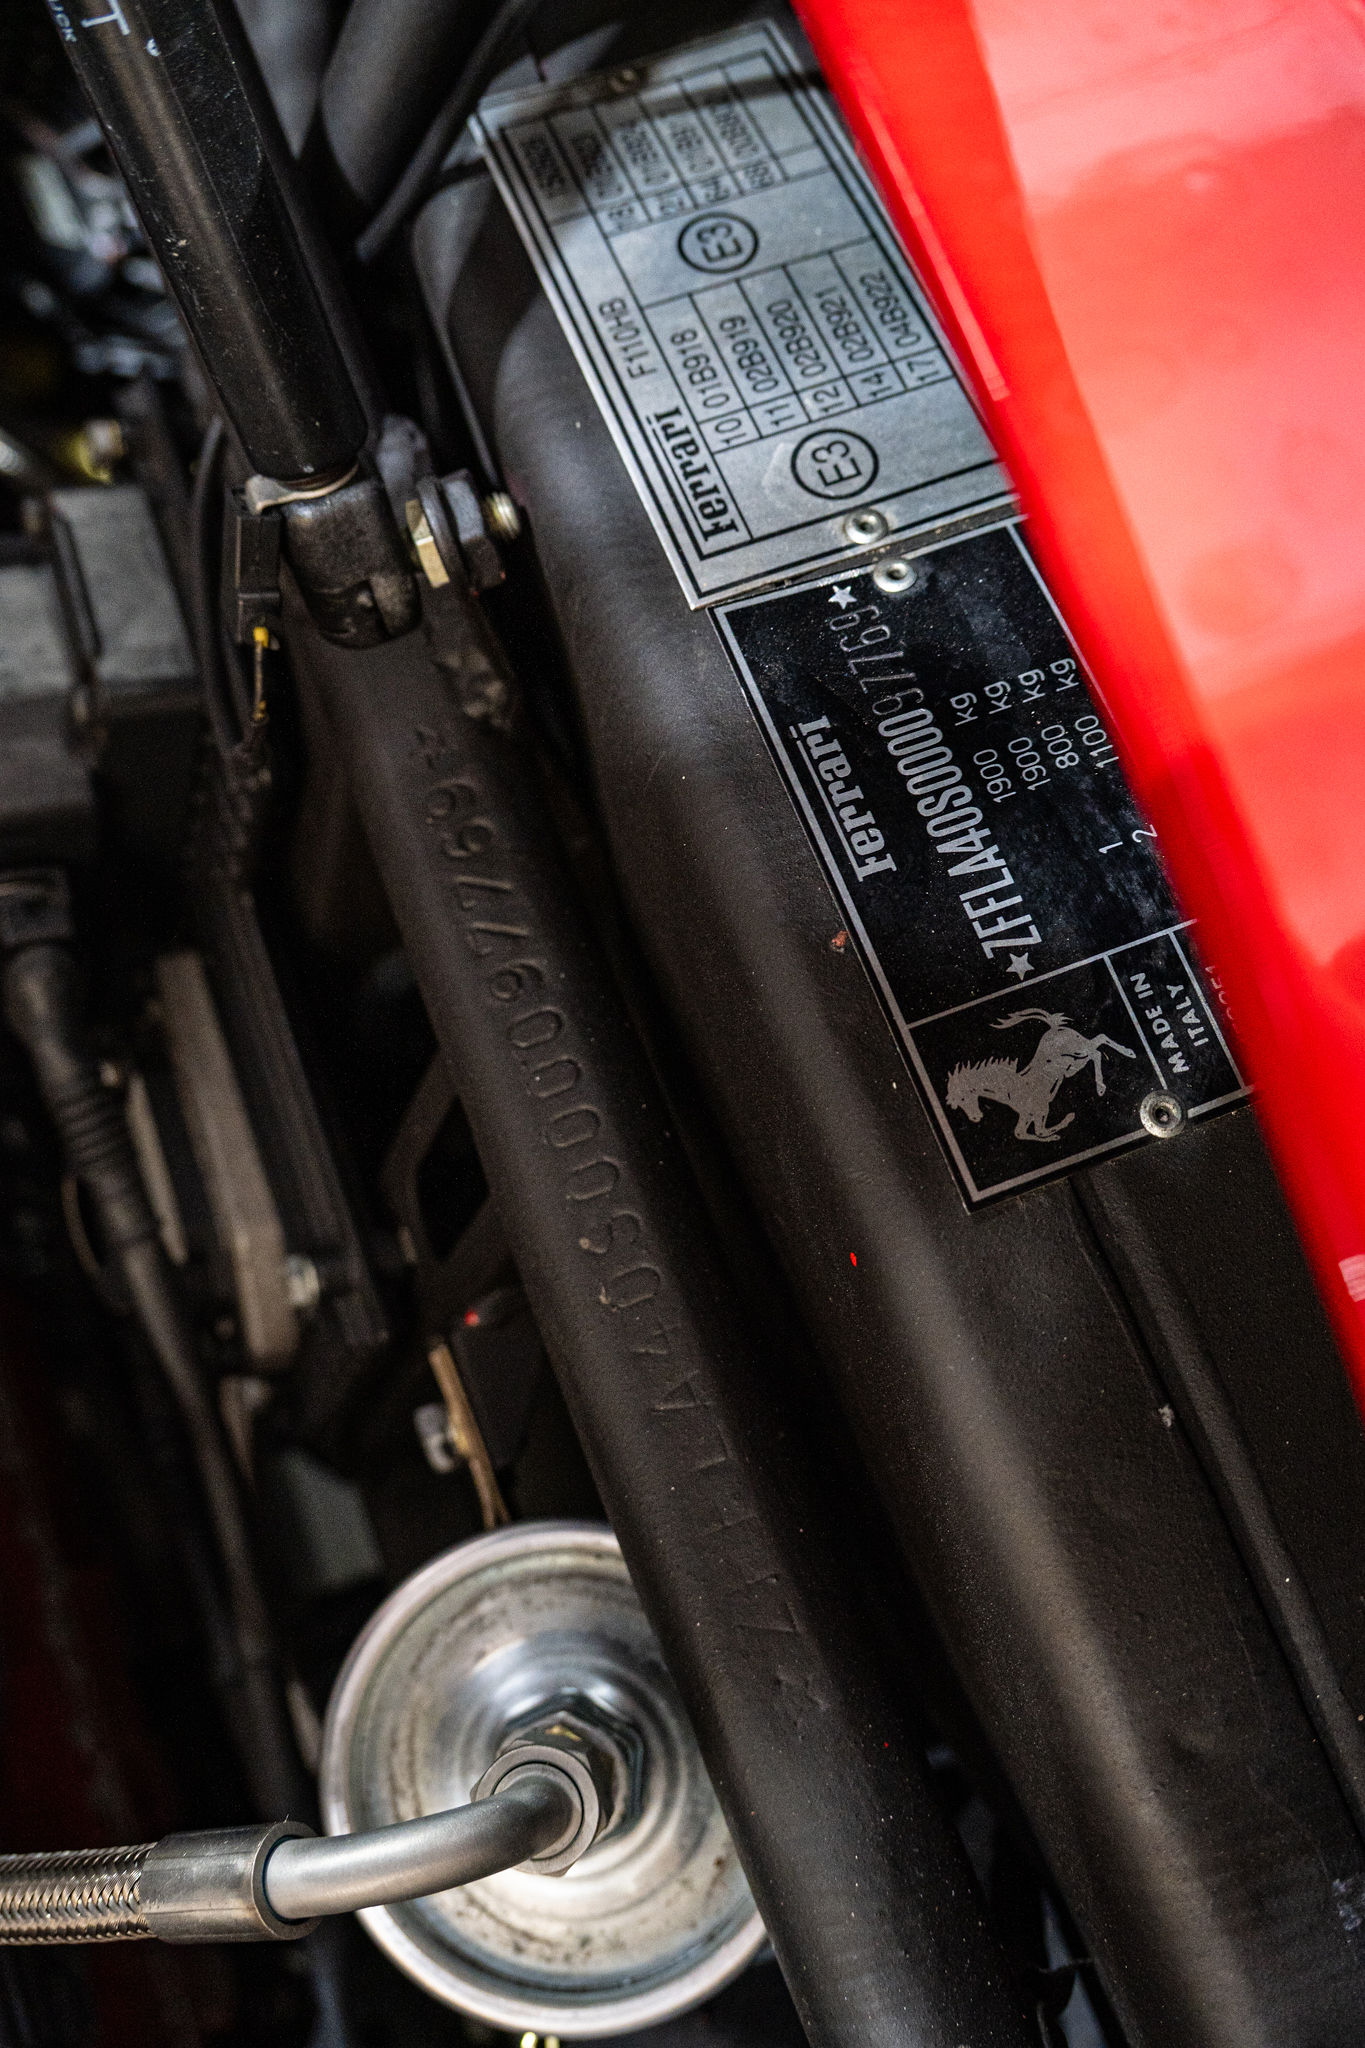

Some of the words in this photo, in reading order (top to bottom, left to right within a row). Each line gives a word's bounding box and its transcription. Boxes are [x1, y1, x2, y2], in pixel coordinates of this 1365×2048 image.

[695, 222, 743, 264] E3
[814, 285, 875, 362] 02B921
[858, 268, 921, 347] 04B922
[598, 297, 657, 379] F110HB
[718, 315, 780, 393] 02B919
[765, 298, 828, 377] 02B920
[669, 328, 730, 409] 01B918
[860, 372, 892, 398] 14
[906, 359, 940, 383] 17
[764, 403, 795, 426] 11
[812, 385, 844, 413] 12
[714, 417, 747, 446] 10
[646, 406, 740, 542] Ferrari
[810, 439, 863, 488] E3
[983, 680, 1012, 715] kg
[1017, 668, 1046, 704] kg
[1049, 658, 1079, 692] kg
[949, 692, 979, 726] kg
[1007, 736, 1051, 791] 1900
[1041, 724, 1080, 769] 800
[1074, 715, 1120, 769] 1100
[788, 715, 898, 883] Ferrari
[973, 748, 1017, 803] 1900
[1098, 841, 1124, 854] 1
[1131, 824, 1158, 843] 2
[1129, 972, 1154, 999] IN
[1166, 984, 1209, 1047] ITALY
[1144, 1005, 1190, 1074] MADE
